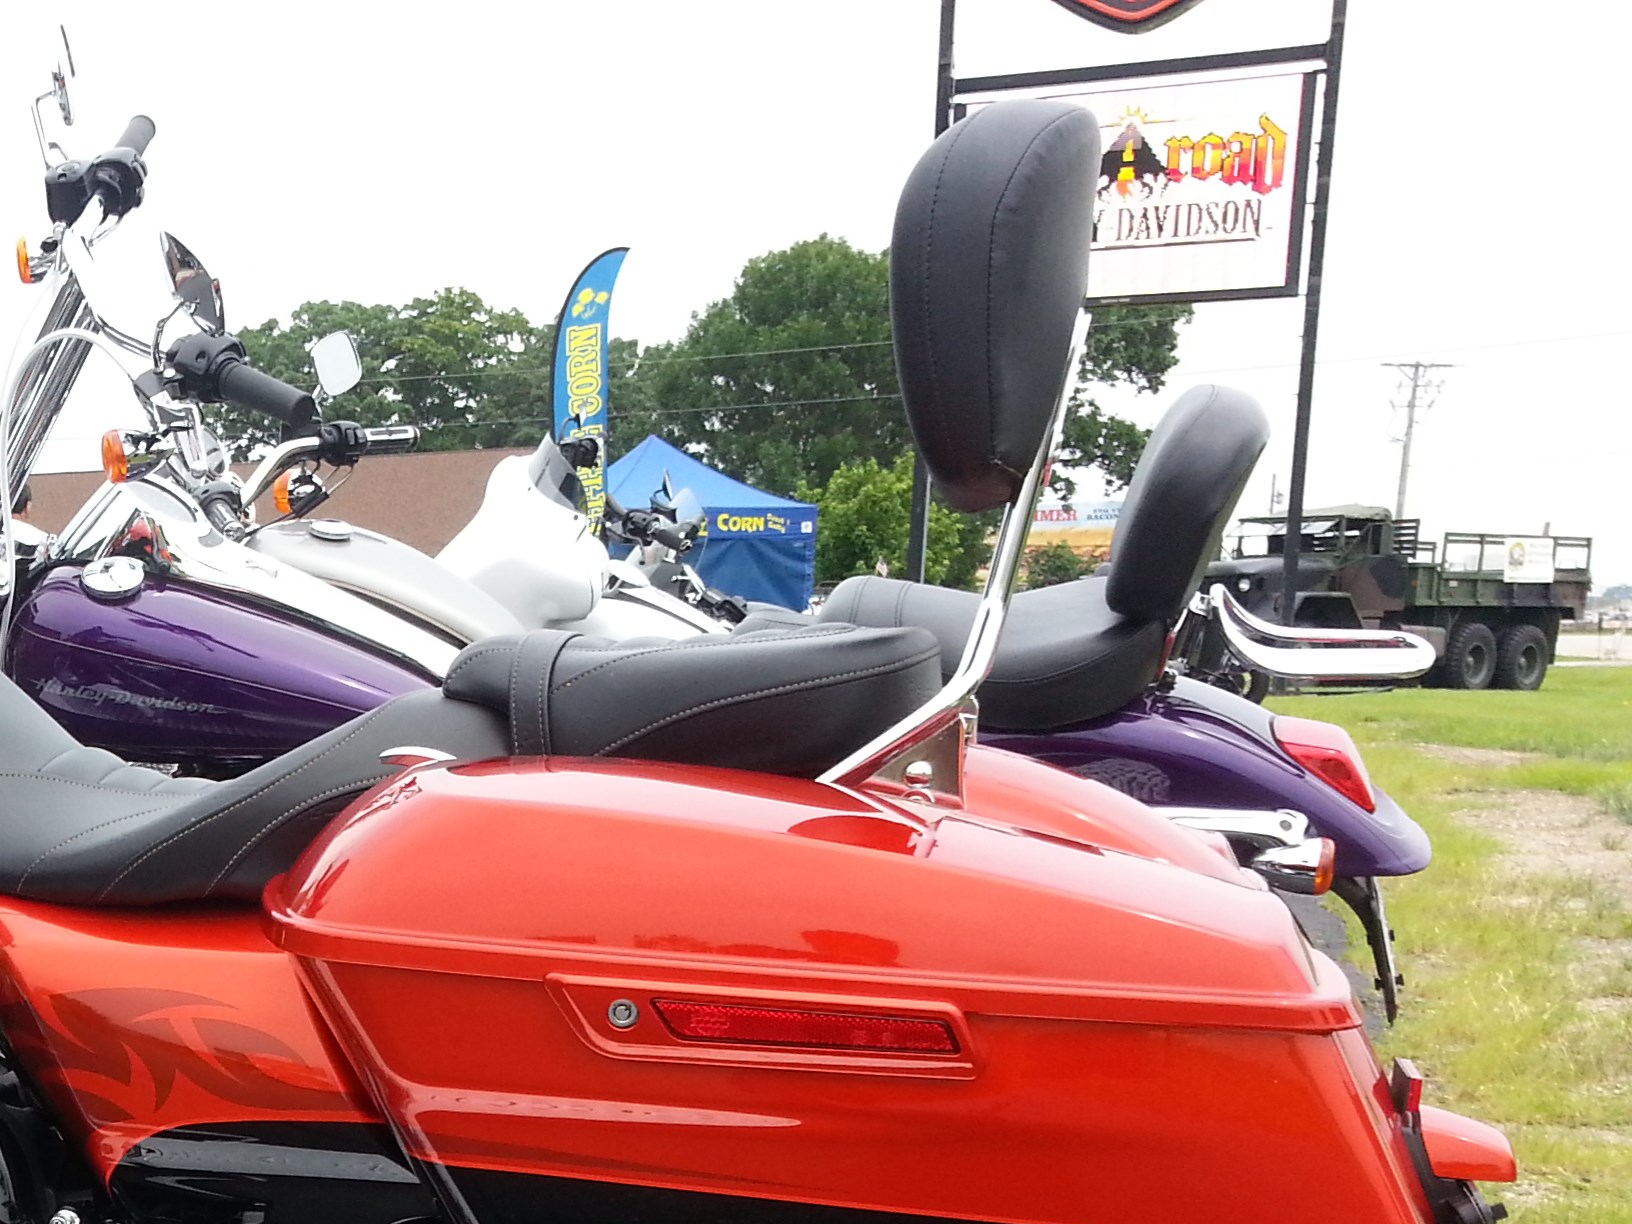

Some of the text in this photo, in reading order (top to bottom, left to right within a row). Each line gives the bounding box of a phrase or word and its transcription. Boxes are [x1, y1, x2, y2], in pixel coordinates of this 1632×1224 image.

[1164, 112, 1287, 195] road
[566, 323, 603, 418] CORN
[717, 513, 765, 532] CORN
[29, 677, 227, 714] Harley-Davidson
